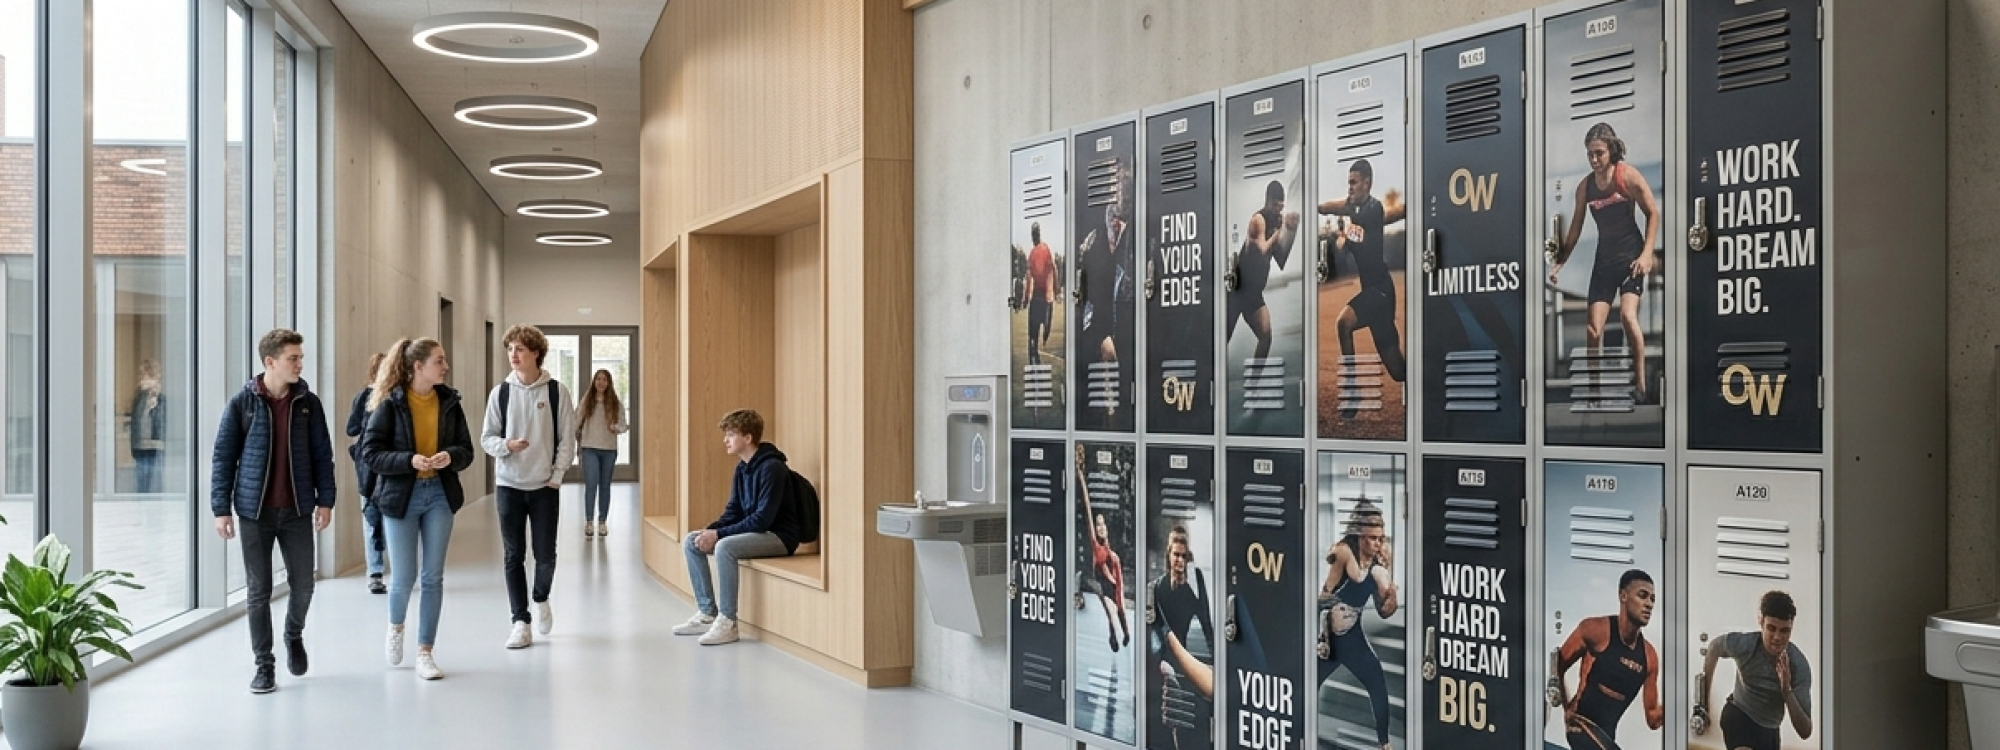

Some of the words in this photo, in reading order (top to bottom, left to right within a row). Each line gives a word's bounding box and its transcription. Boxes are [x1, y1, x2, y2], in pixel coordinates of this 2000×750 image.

[1716, 139, 1800, 186] WORK
[1448, 167, 1499, 212] OW
[1717, 186, 1802, 230] HARD.
[1160, 211, 1197, 244] FIND
[1160, 243, 1202, 275] YOUR
[1717, 227, 1816, 272] DREAM
[1160, 275, 1202, 307] EDGE
[1428, 262, 1520, 296] LIMITLESS
[1717, 276, 1769, 316] BIG.
[1162, 376, 1197, 412] OW
[1722, 363, 1787, 416] OW
[1735, 484, 1768, 499] A120
[1022, 533, 1054, 563] FIND
[1246, 542, 1285, 582] OW
[1020, 561, 1056, 594] YOUR
[1438, 562, 1506, 603] WORK
[1021, 592, 1056, 625] EDGE
[1439, 598, 1507, 642] HARD.
[1439, 637, 1509, 679] DREAM
[1237, 668, 1293, 716] YOUR
[1438, 675, 1496, 733] BIG.
[1238, 709, 1293, 750] EDGE
